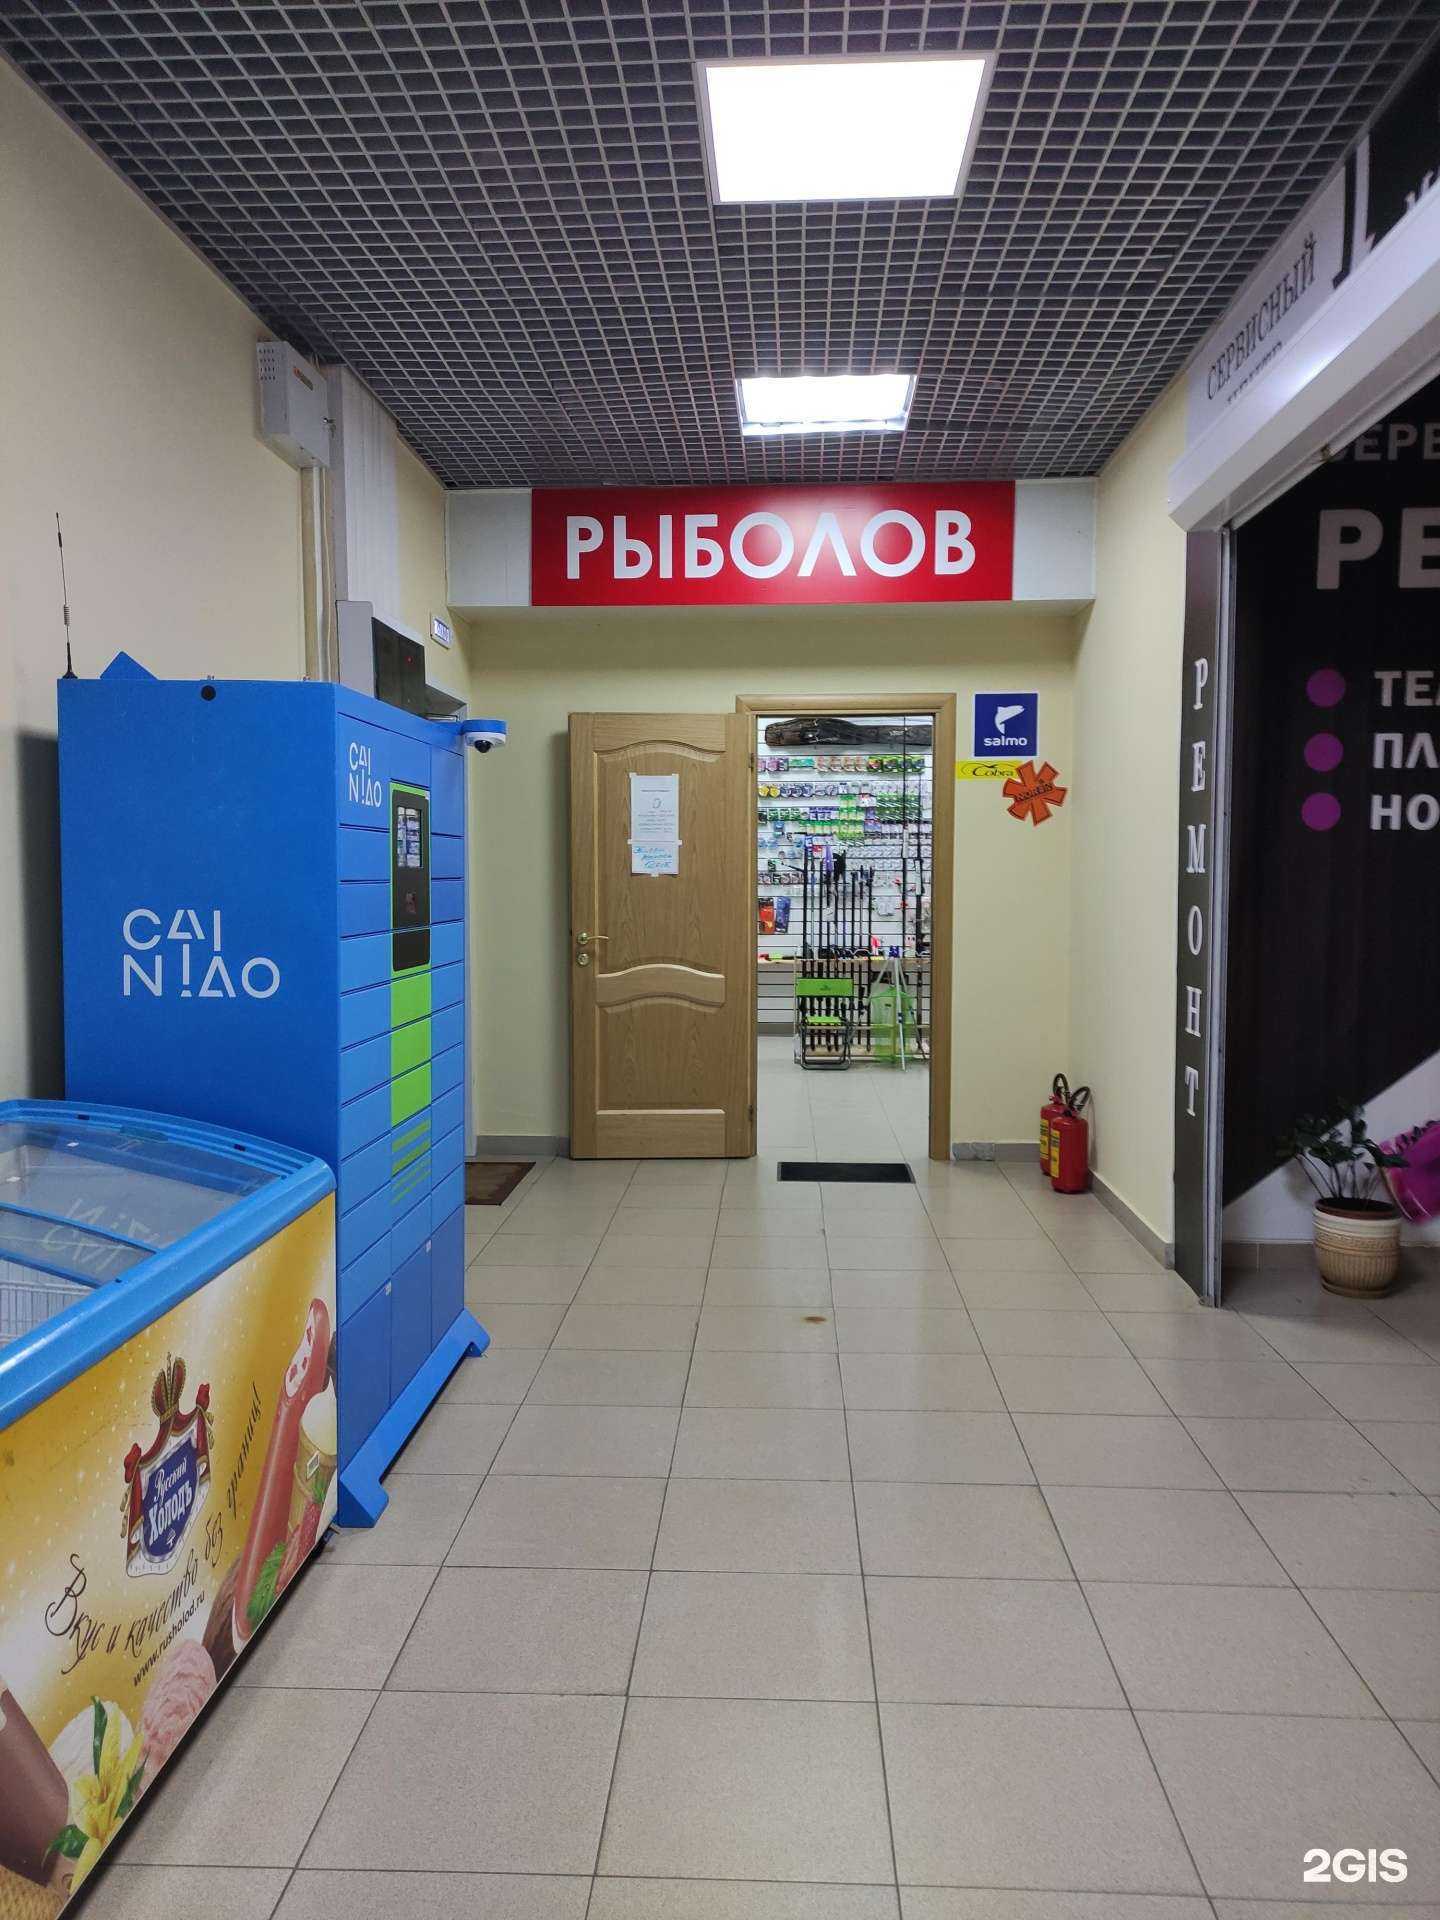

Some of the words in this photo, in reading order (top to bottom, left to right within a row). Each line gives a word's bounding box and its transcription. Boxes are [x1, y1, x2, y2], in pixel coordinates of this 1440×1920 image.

[1207, 232, 1316, 401] СЕРВИСНЫЙ
[566, 509, 976, 579] РЫБОЛОВ
[1316, 507, 1440, 589] РЕ
[1373, 670, 1440, 706] ТЕ
[983, 735, 1028, 747] salmo
[1184, 658, 1208, 1117] РЕМОНТ
[123, 908, 221, 951] CAI
[45, 1553, 105, 1675] Вкус
[106, 1623, 122, 1654] и
[132, 1590, 206, 1687] www.rusholod.ru
